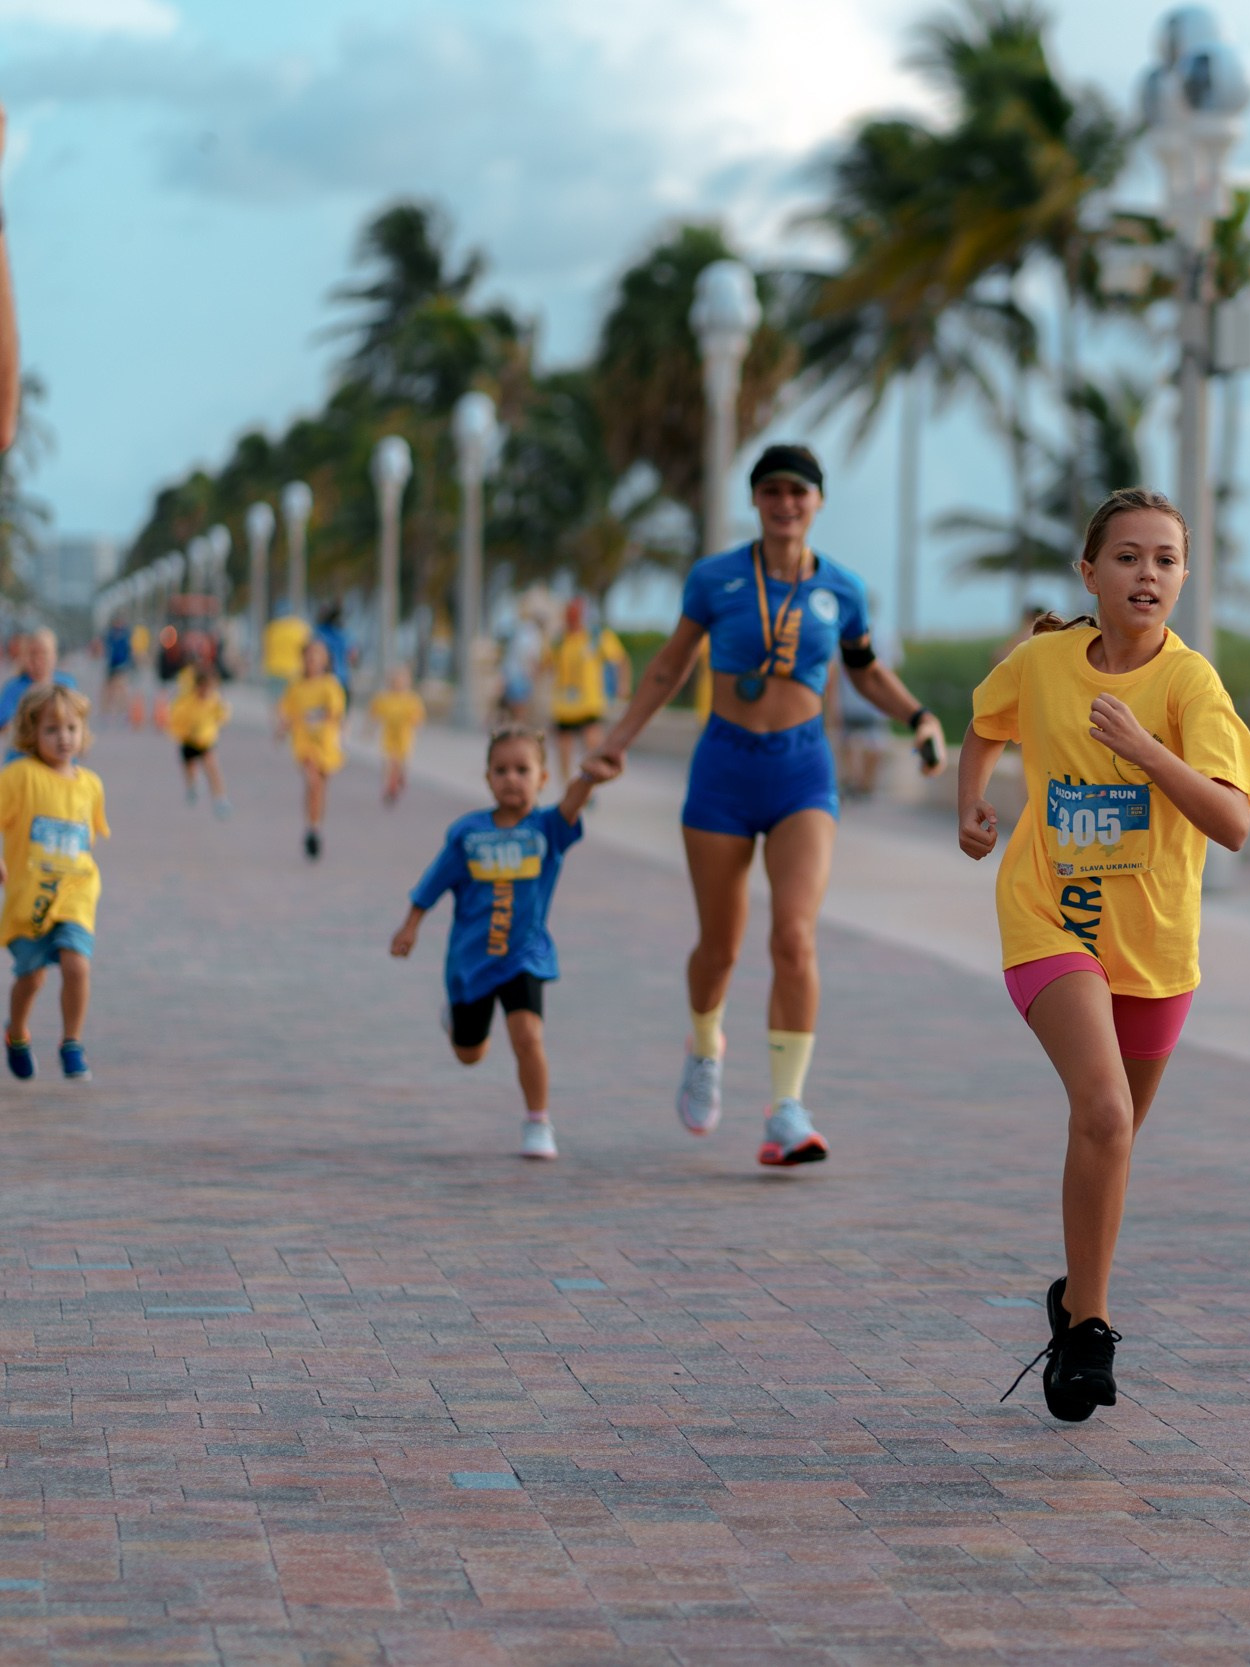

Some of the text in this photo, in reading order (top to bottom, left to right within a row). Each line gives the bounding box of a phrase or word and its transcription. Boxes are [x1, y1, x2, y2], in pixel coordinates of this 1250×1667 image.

[1109, 790, 1137, 800] RUN
[1057, 806, 1121, 847] 305
[1080, 865, 1105, 873] SLAVA
